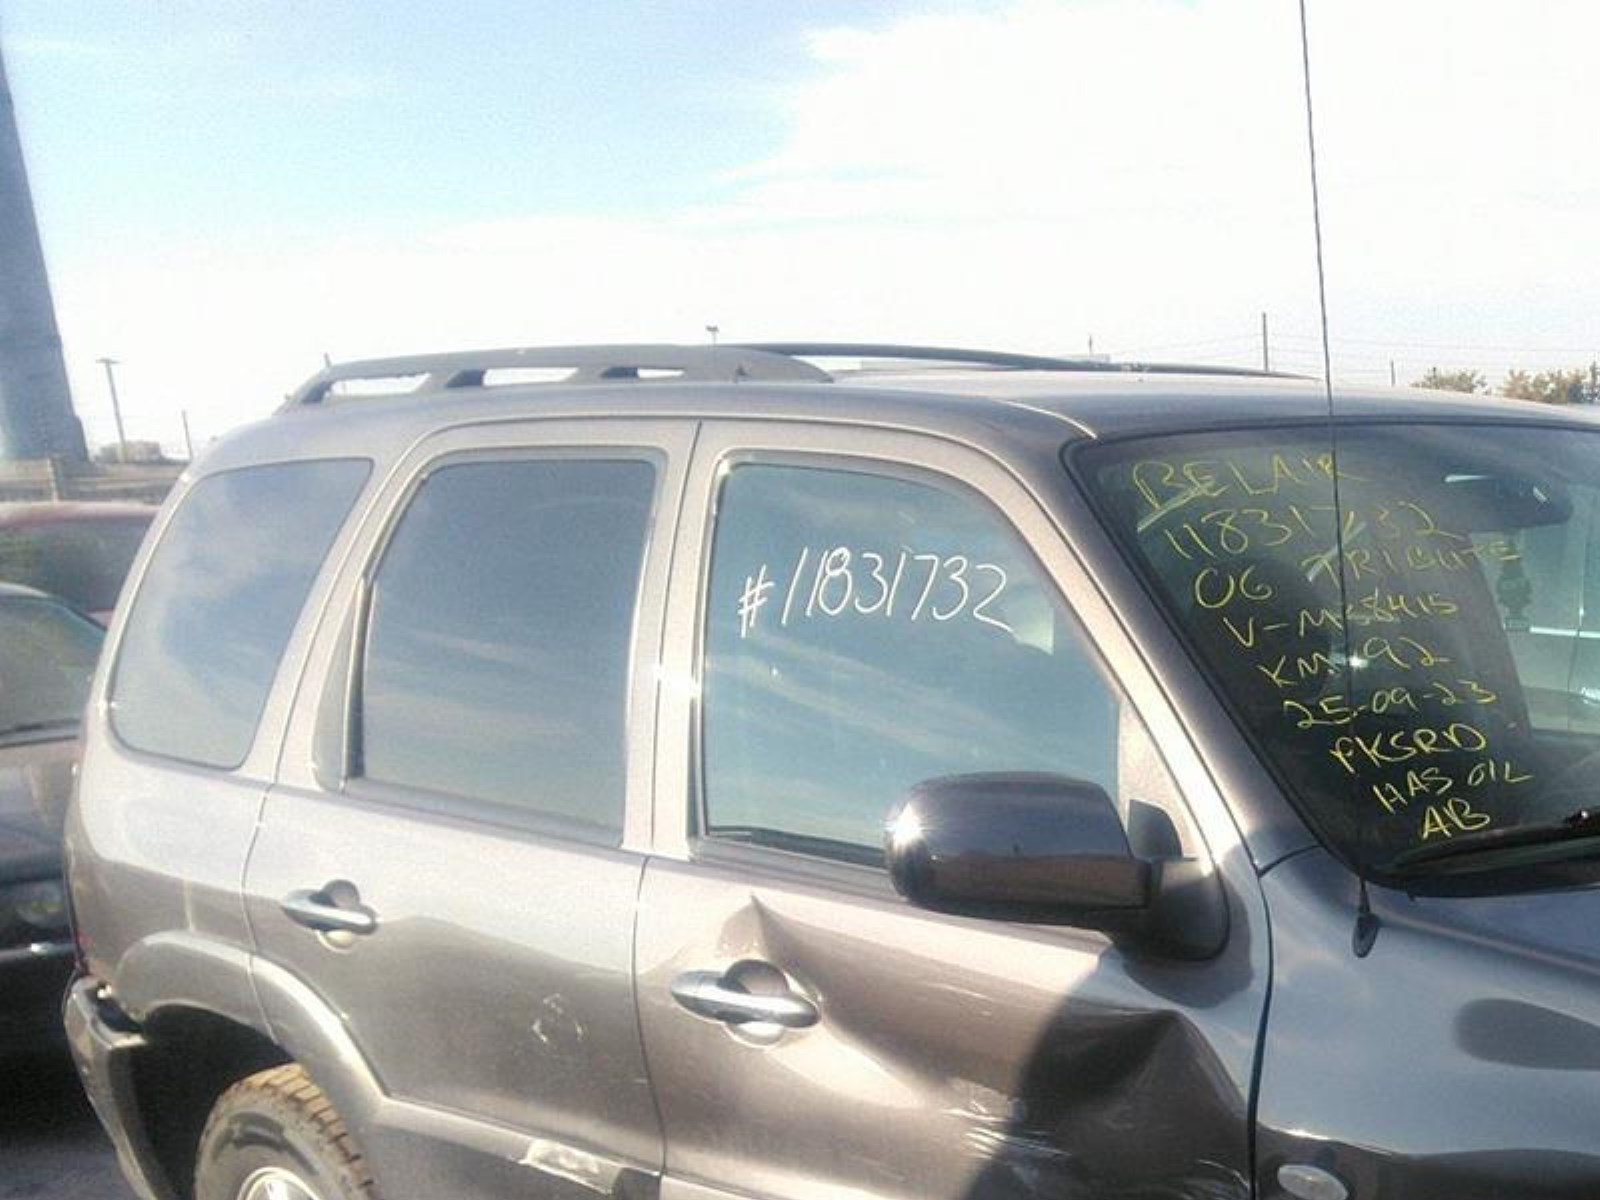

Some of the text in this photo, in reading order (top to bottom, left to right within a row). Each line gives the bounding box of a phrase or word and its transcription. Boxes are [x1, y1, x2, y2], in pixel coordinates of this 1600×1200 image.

[737, 546, 1014, 638] #11831732
[1195, 566, 1273, 609] 06
[1373, 760, 1533, 814] HAS OIL
[1421, 797, 1490, 840] AB
